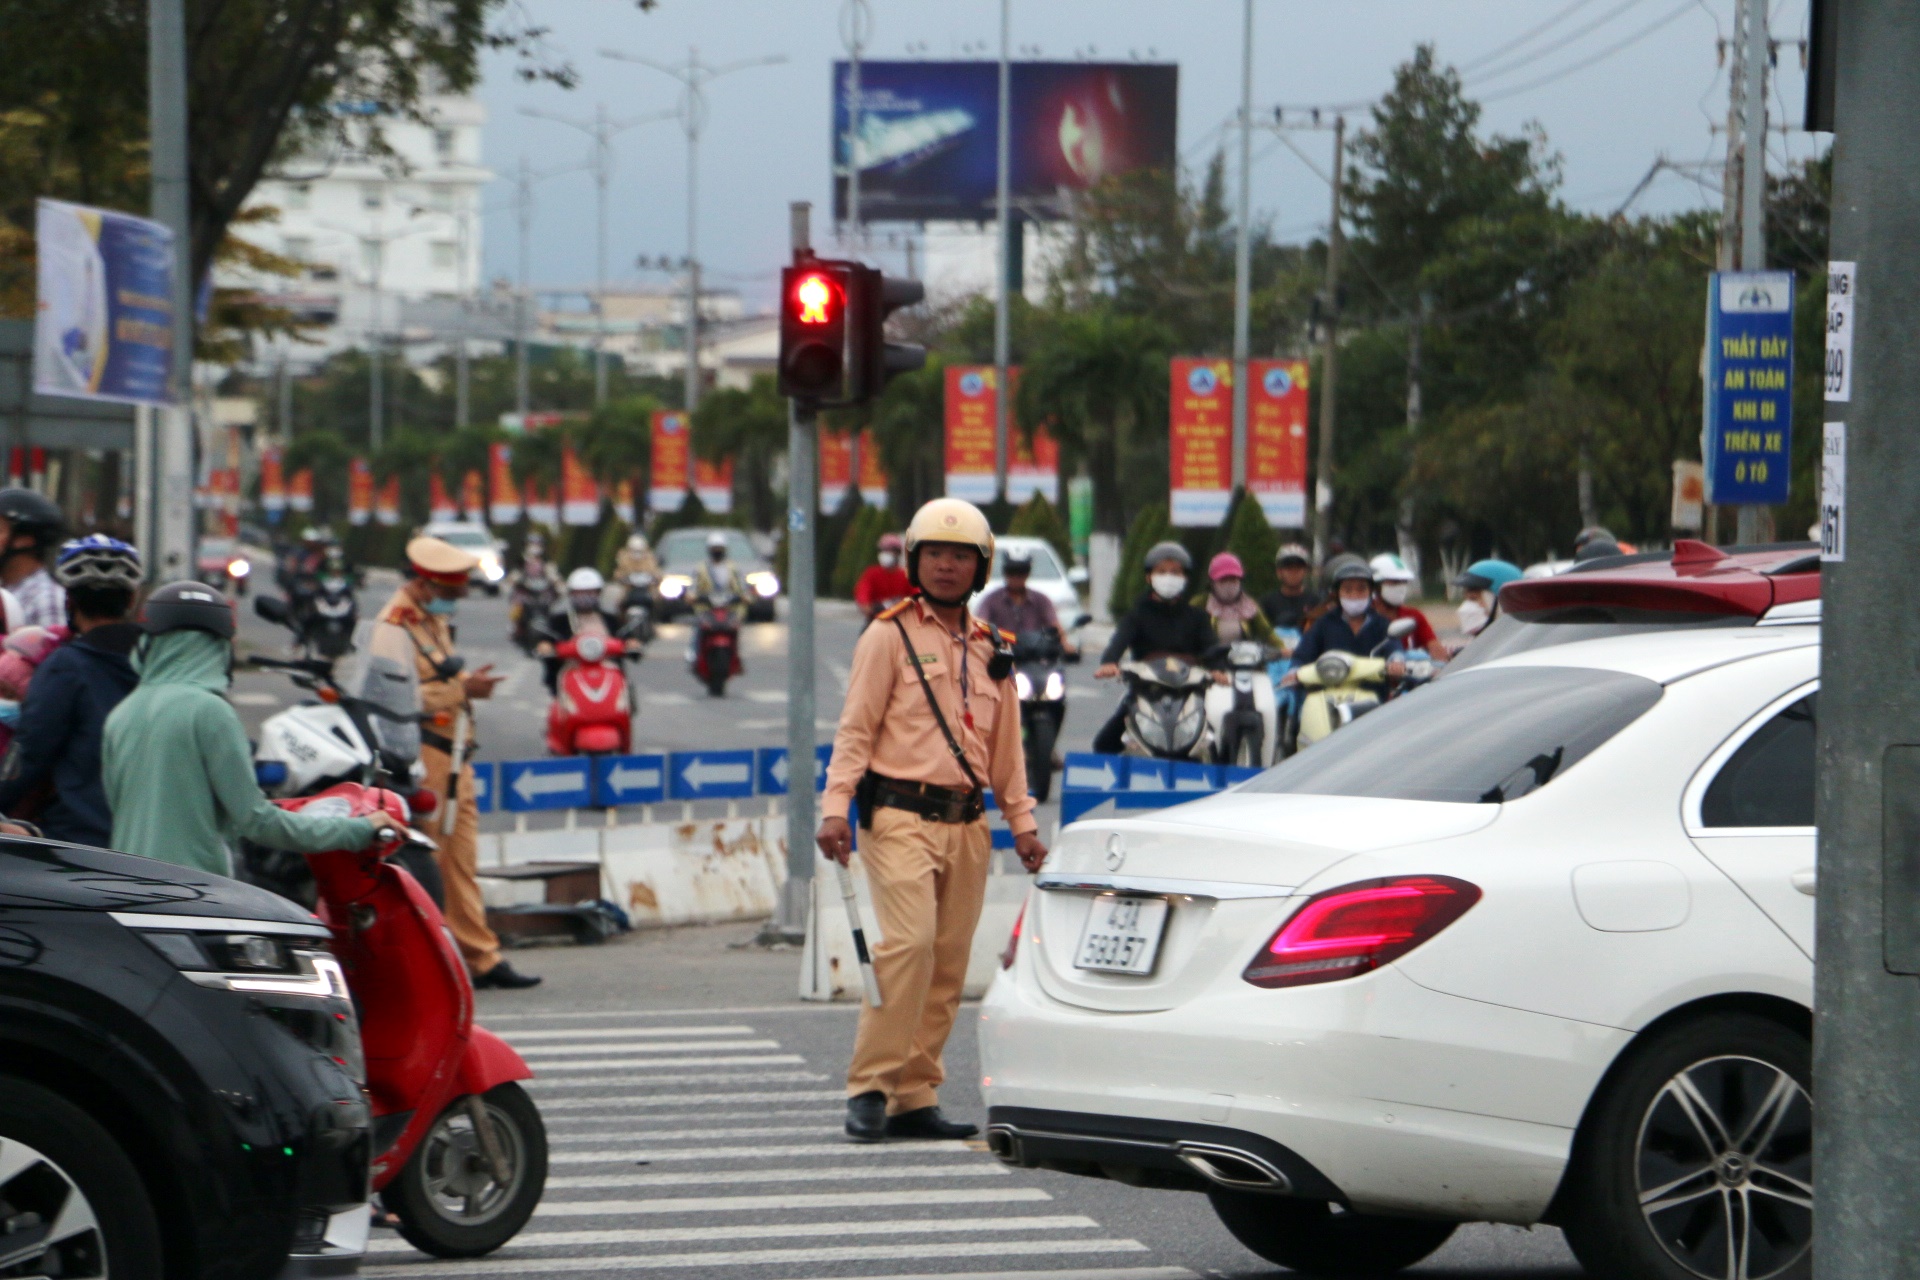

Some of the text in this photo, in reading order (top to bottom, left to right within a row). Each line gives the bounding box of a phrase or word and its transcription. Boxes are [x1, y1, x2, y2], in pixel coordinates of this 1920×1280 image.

[1760, 335, 1788, 358] DÂY
[1724, 367, 1786, 390] AN TOÀN
[1732, 400, 1757, 421] KHI
[1764, 431, 1782, 452] XE
